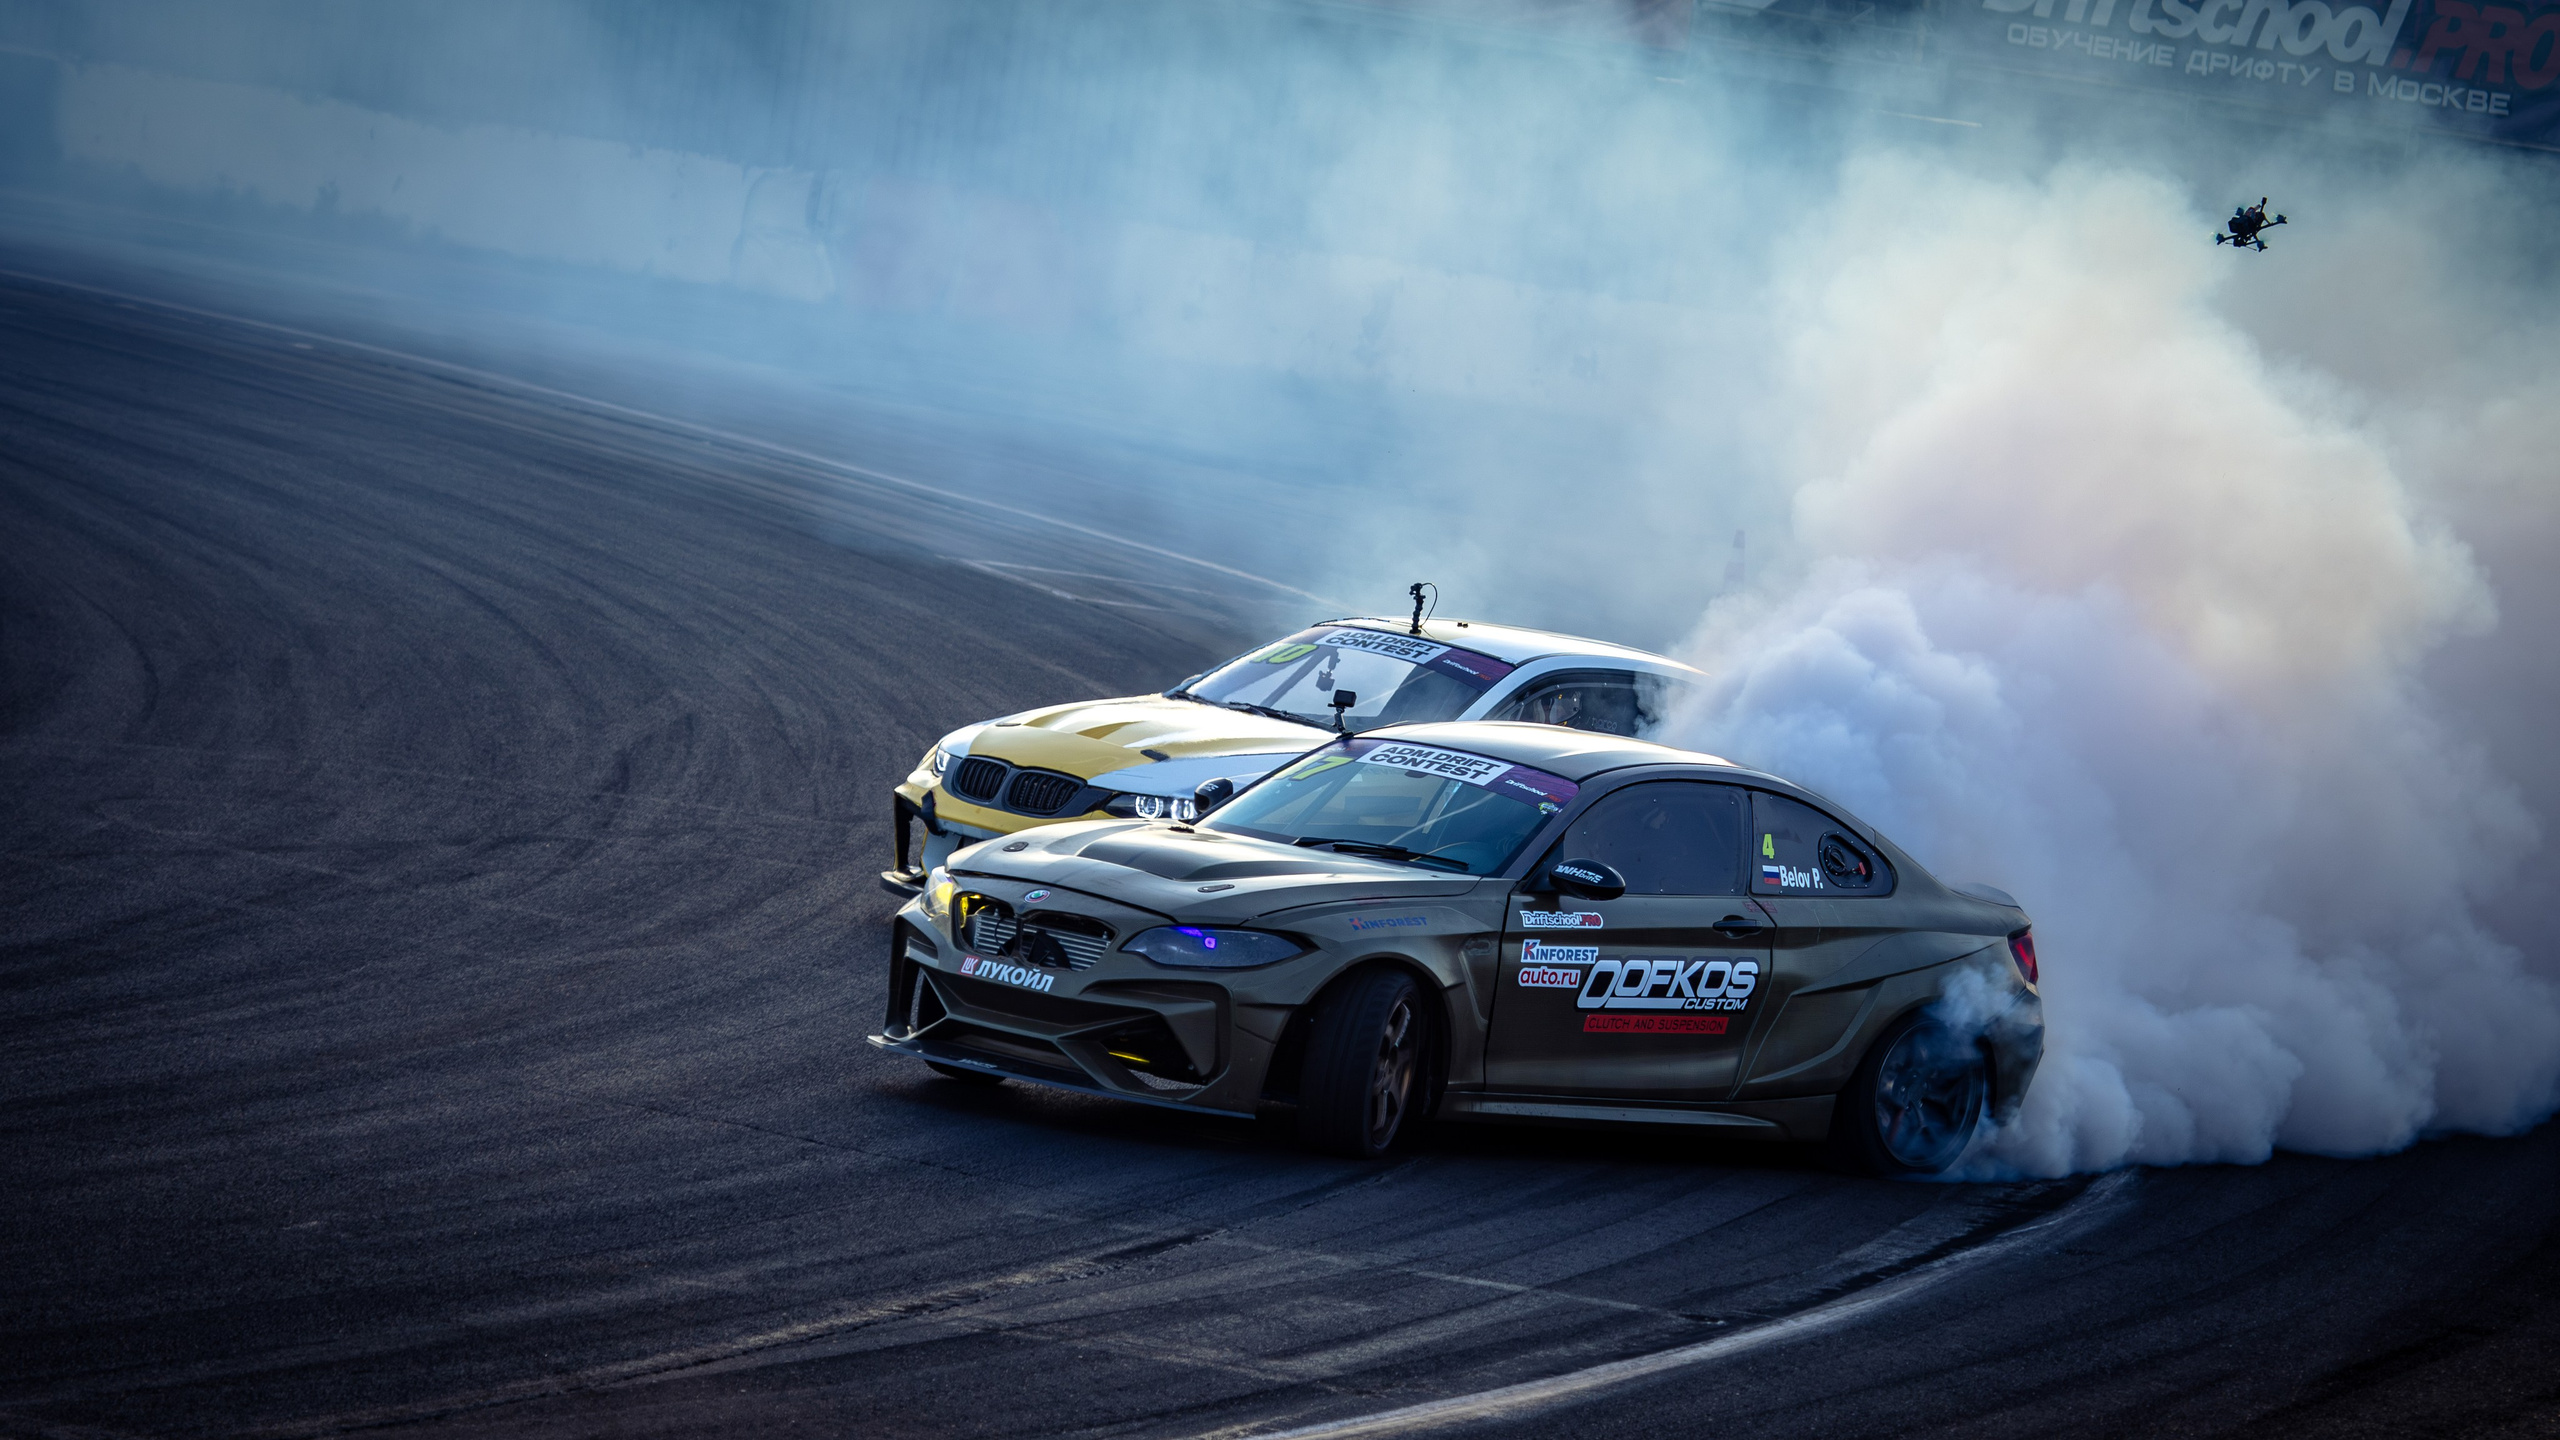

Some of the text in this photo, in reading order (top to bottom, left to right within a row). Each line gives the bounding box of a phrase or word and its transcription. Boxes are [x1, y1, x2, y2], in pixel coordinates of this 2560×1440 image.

[2007, 22, 2511, 116] ОБУЧЕНИЕ ДРИФТУ В МОСКВЕ
[1325, 636, 1430, 659] CONTEST
[1336, 630, 1441, 652] ADM DRIFT
[1369, 753, 1490, 780] CONTEST
[1380, 745, 1502, 772] ADM DRIFT
[1762, 833, 1775, 859] 4
[1779, 865, 1824, 889] Belov P.
[1523, 941, 1597, 962] KINFOREST
[975, 960, 1055, 992] ЛУКОЙЛ
[1520, 968, 1579, 986] auto.ru
[1684, 998, 1749, 1010] CUSTOM
[1588, 1017, 1724, 1032] CLUTCH AND SUSPENSION
